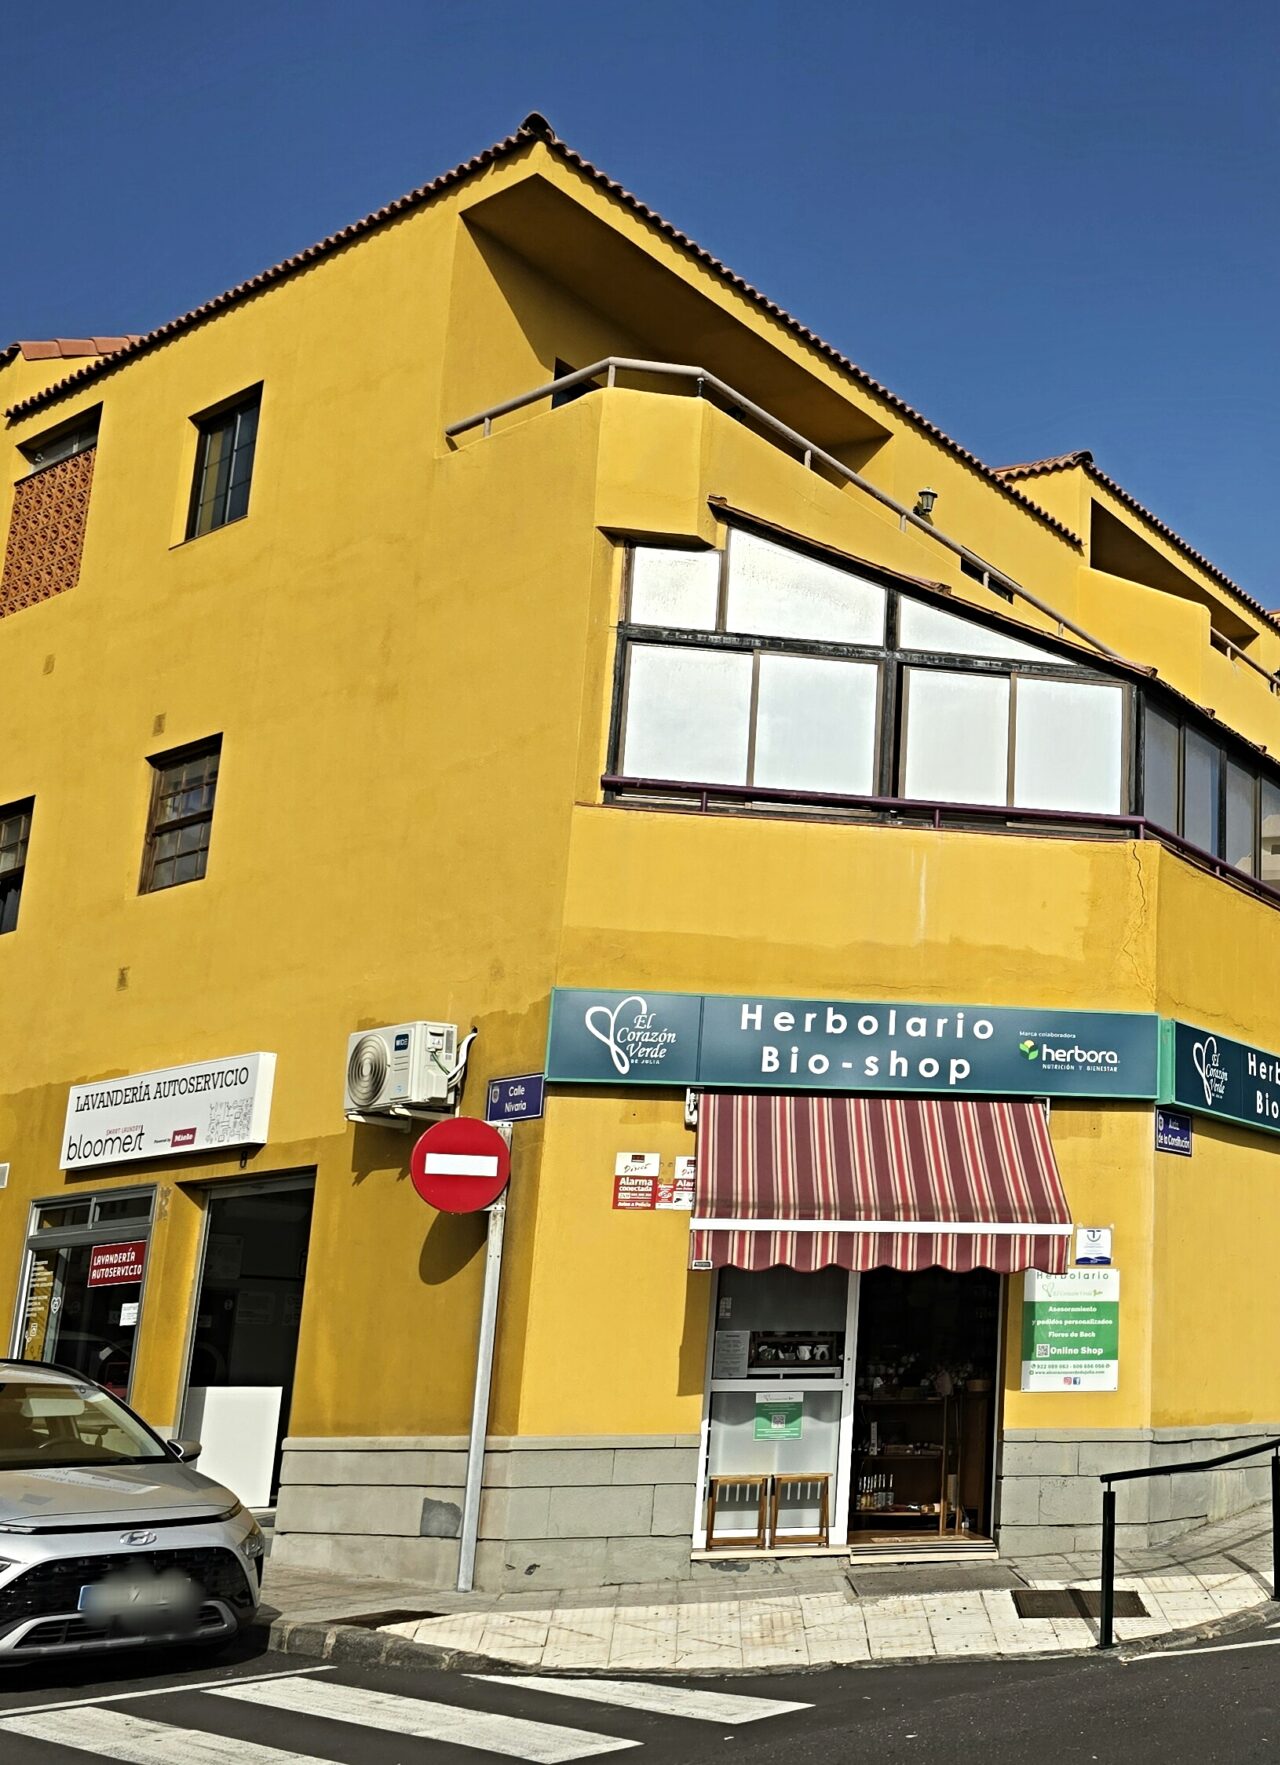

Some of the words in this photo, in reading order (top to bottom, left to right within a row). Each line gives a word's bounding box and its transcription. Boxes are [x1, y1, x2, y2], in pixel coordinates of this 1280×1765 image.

[634, 1013, 656, 1030] El
[740, 1003, 994, 1040] Herbolario
[616, 1027, 677, 1044] Corazón
[1038, 1031, 1076, 1039] colaboradora
[625, 1044, 667, 1060] Verde
[1042, 1044, 1119, 1064] herbora
[761, 1046, 971, 1085] Bio-shop
[1042, 1063, 1075, 1071] NUTRICIÓN
[75, 1081, 151, 1112] LAVANDERÍA
[153, 1066, 249, 1100] AUTOSERVICIO
[508, 1085, 525, 1097] Calle
[504, 1101, 527, 1113] Nivaria
[66, 1124, 146, 1161] bloomest
[1158, 1132, 1163, 1143] de
[1168, 1133, 1190, 1148] Constitución
[619, 1177, 653, 1186] Alarma
[93, 1247, 136, 1266] LAVANDERÍA
[92, 1264, 142, 1280] AUTOSERVICIO
[1036, 1318, 1063, 1326] pedidos
[1050, 1346, 1078, 1354] Online
[1080, 1346, 1104, 1355] Shop
